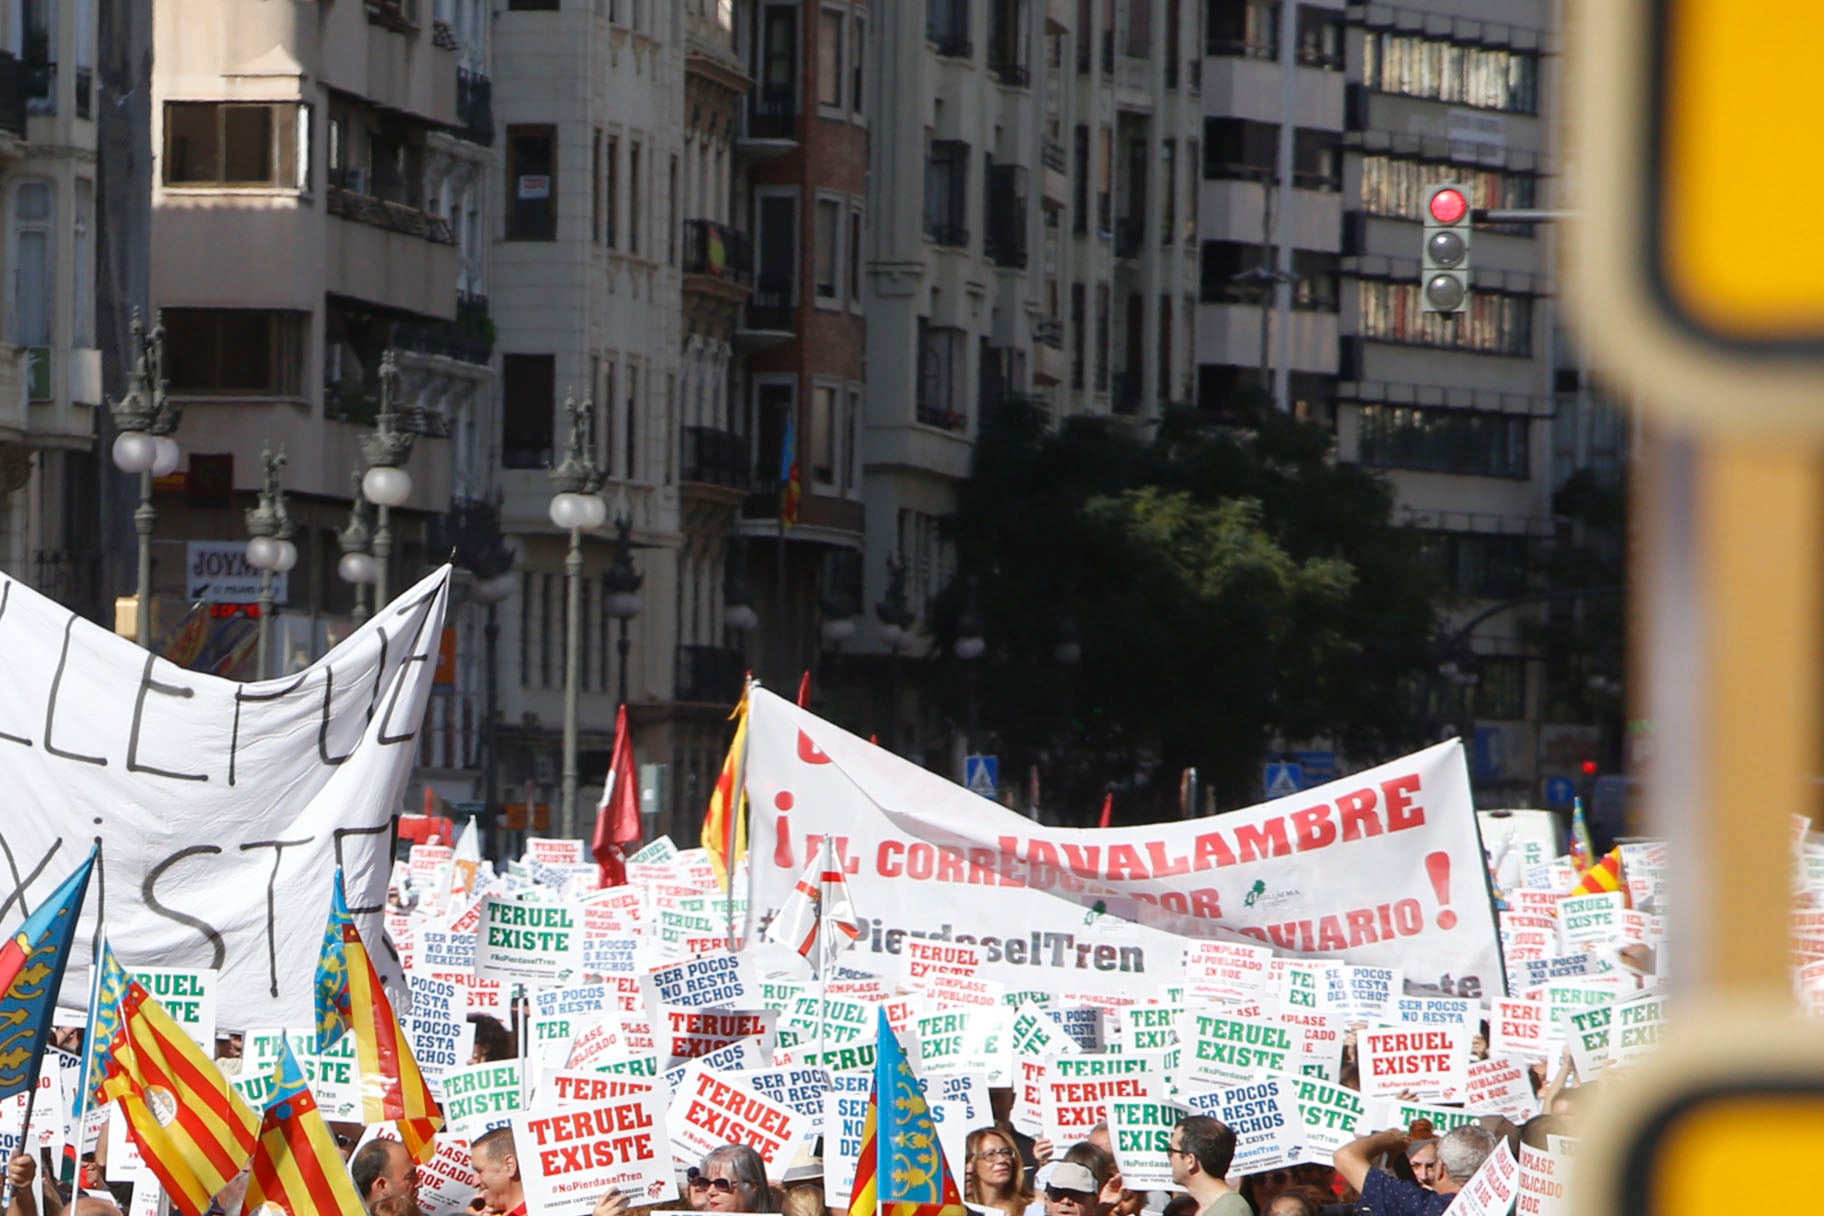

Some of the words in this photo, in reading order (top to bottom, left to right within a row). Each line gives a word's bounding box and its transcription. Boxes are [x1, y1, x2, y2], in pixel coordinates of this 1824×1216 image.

[488, 903, 573, 929] TERUEL
[1564, 897, 1613, 914] TERUEL
[1567, 914, 1613, 930] EXISTE
[488, 928, 570, 952] EXISTE
[910, 943, 979, 966] TERUEL
[1205, 955, 1263, 972] PUBLICADO
[1526, 958, 1551, 970] SER
[1554, 954, 1588, 966] POCOS
[654, 970, 684, 986] SER
[688, 956, 739, 978] POCOS
[1205, 967, 1218, 977] EN
[1221, 969, 1243, 981] BOE
[1353, 968, 1393, 981] POCOS
[1530, 968, 1545, 979] NO
[1549, 964, 1587, 977] RESTA
[537, 992, 560, 1005] SER
[566, 986, 605, 1001] POCOS
[661, 985, 681, 999] NO
[686, 973, 739, 992] RESTA
[541, 1006, 557, 1017] NO
[561, 1001, 602, 1015] RESTA
[1398, 1001, 1422, 1012] SER
[1427, 1000, 1468, 1012] POCOS
[412, 1019, 461, 1038] POCOS
[668, 1012, 766, 1035] TERUEL
[1402, 1012, 1418, 1024] NO
[1422, 1012, 1464, 1024] RESTA
[1195, 1015, 1292, 1050] TERUEL
[1367, 1031, 1454, 1053] TERUEL
[1196, 1040, 1284, 1073] EXISTE
[1372, 1054, 1452, 1077] EXISTE
[444, 1067, 519, 1097] TERUEL
[751, 1075, 786, 1091] SER
[450, 1092, 520, 1122] EXISTE
[696, 1072, 792, 1141] TERUEL
[1188, 1092, 1221, 1111] SER
[1226, 1081, 1280, 1102] POCOS
[1224, 1100, 1279, 1121] RESTA
[529, 1103, 653, 1145] TERUEL
[540, 1134, 654, 1177] EXISTE
[552, 1172, 643, 1194] #NoPierdaselTren
[1521, 1195, 1540, 1214] BOE
